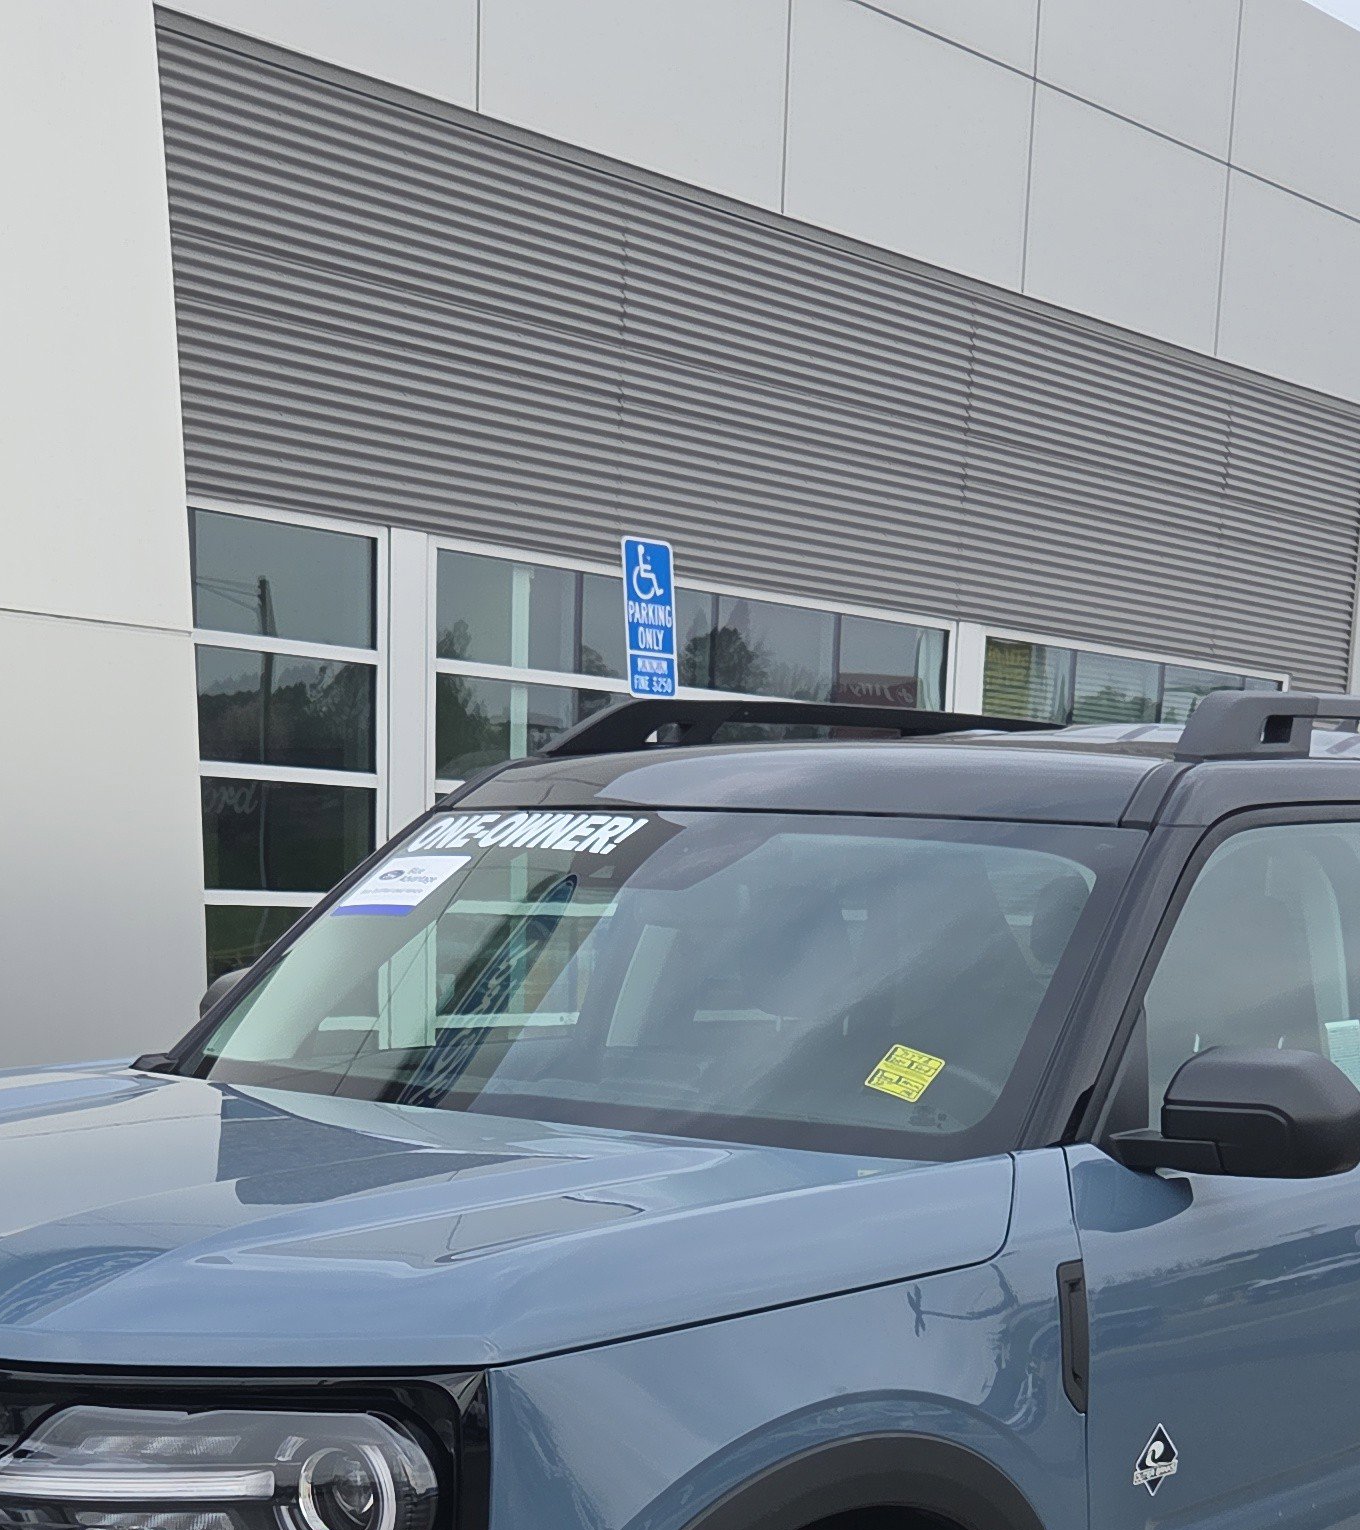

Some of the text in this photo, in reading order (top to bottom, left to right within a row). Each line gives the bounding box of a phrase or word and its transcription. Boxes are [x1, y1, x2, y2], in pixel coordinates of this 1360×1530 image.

[628, 600, 672, 627] PARKING
[638, 627, 664, 650] ONLY
[634, 674, 672, 693] FINE $250
[407, 811, 649, 855] ONE-OWNER!
